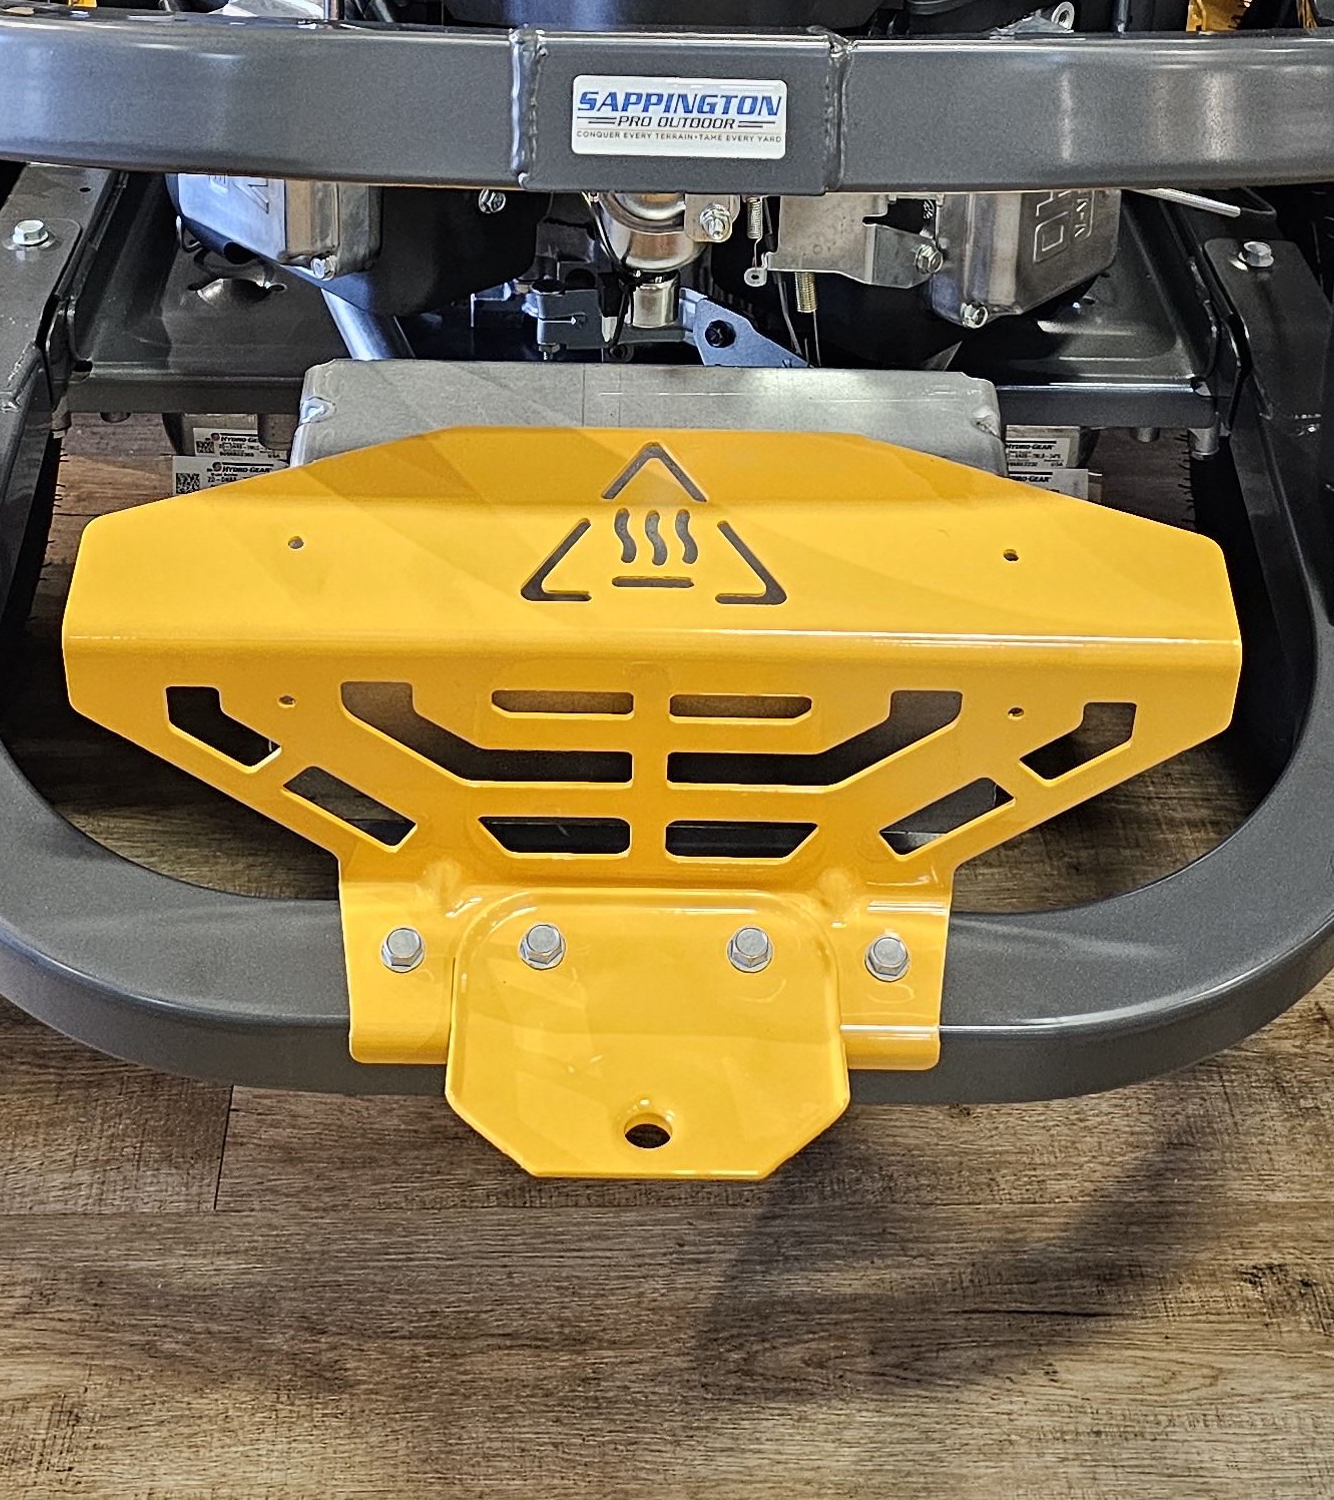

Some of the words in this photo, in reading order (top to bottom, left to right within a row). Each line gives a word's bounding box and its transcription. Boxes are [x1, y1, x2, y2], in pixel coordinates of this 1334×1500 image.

[577, 91, 782, 116] SAPPINGTON
[617, 116, 652, 127] PRO
[657, 116, 735, 129] OUTDOOR
[576, 130, 620, 138] CONQUER
[726, 134, 755, 142] EVERY
